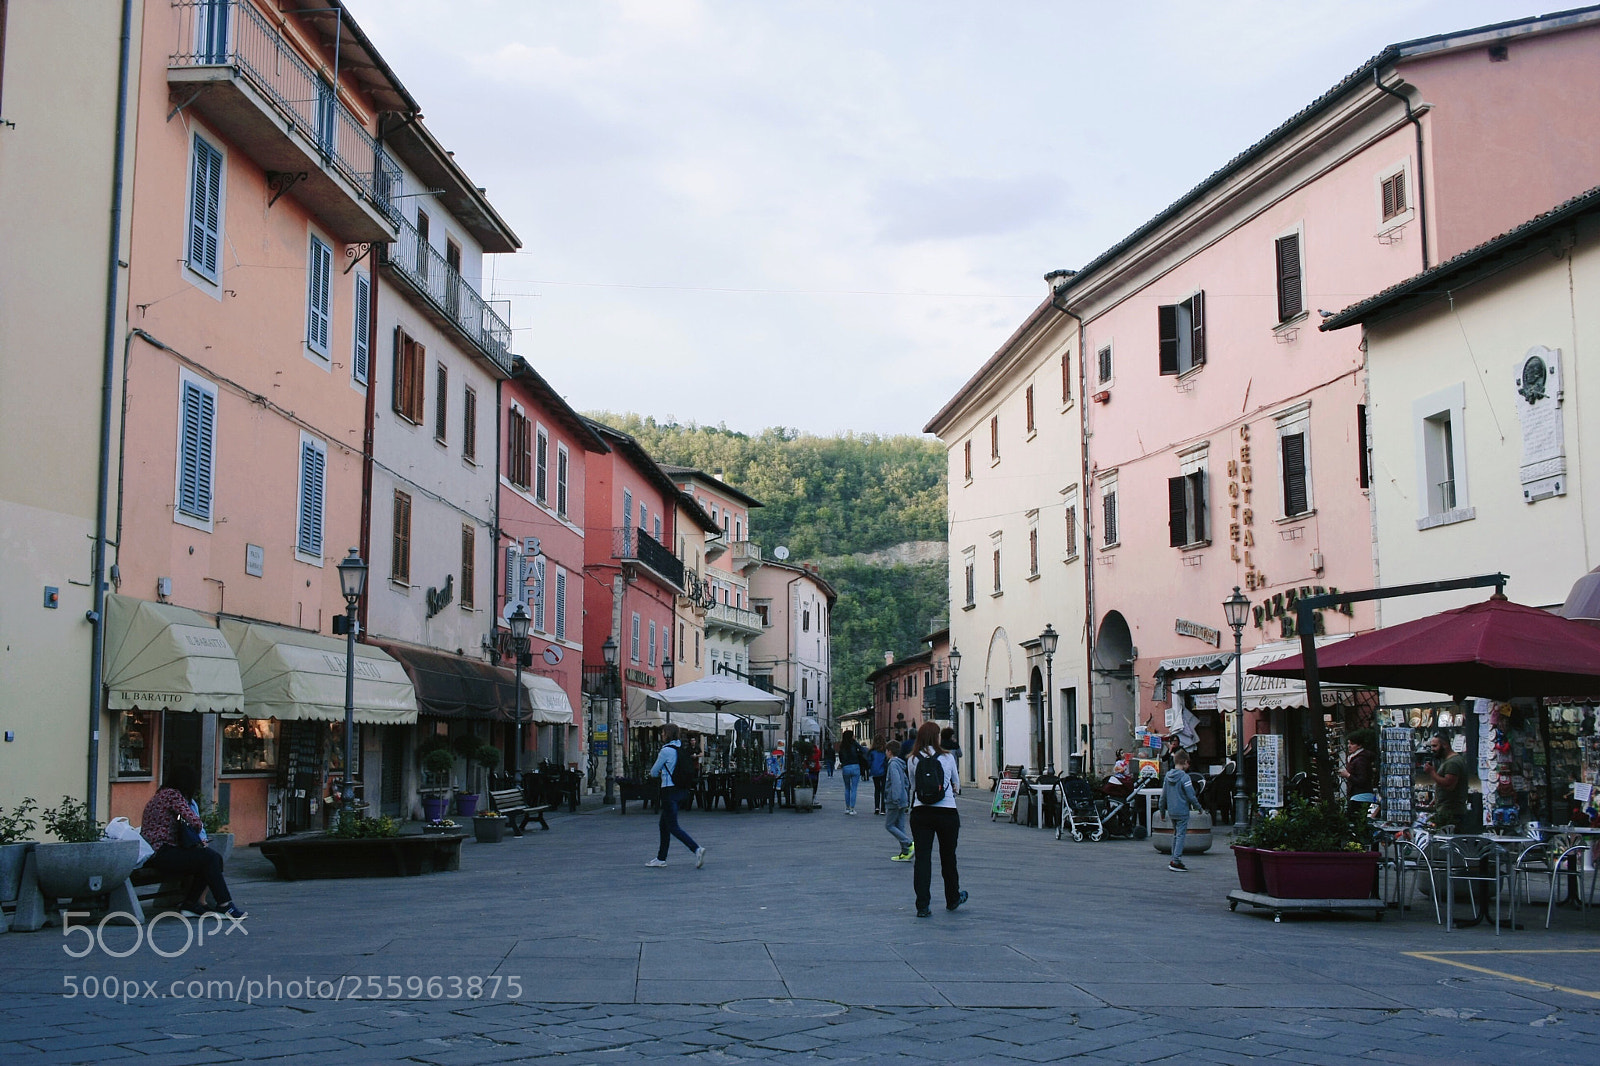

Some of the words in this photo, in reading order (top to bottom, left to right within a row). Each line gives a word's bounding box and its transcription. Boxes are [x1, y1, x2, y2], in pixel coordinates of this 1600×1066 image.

[1227, 460, 1240, 562] HOTEL
[521, 536, 541, 606] BAR
[1280, 611, 1326, 638] BR
[333, 656, 381, 679] BATTO
[121, 692, 131, 700] IL
[133, 692, 183, 703] BARATTO
[1259, 695, 1283, 706] Ciccio
[1321, 693, 1343, 704] BAR
